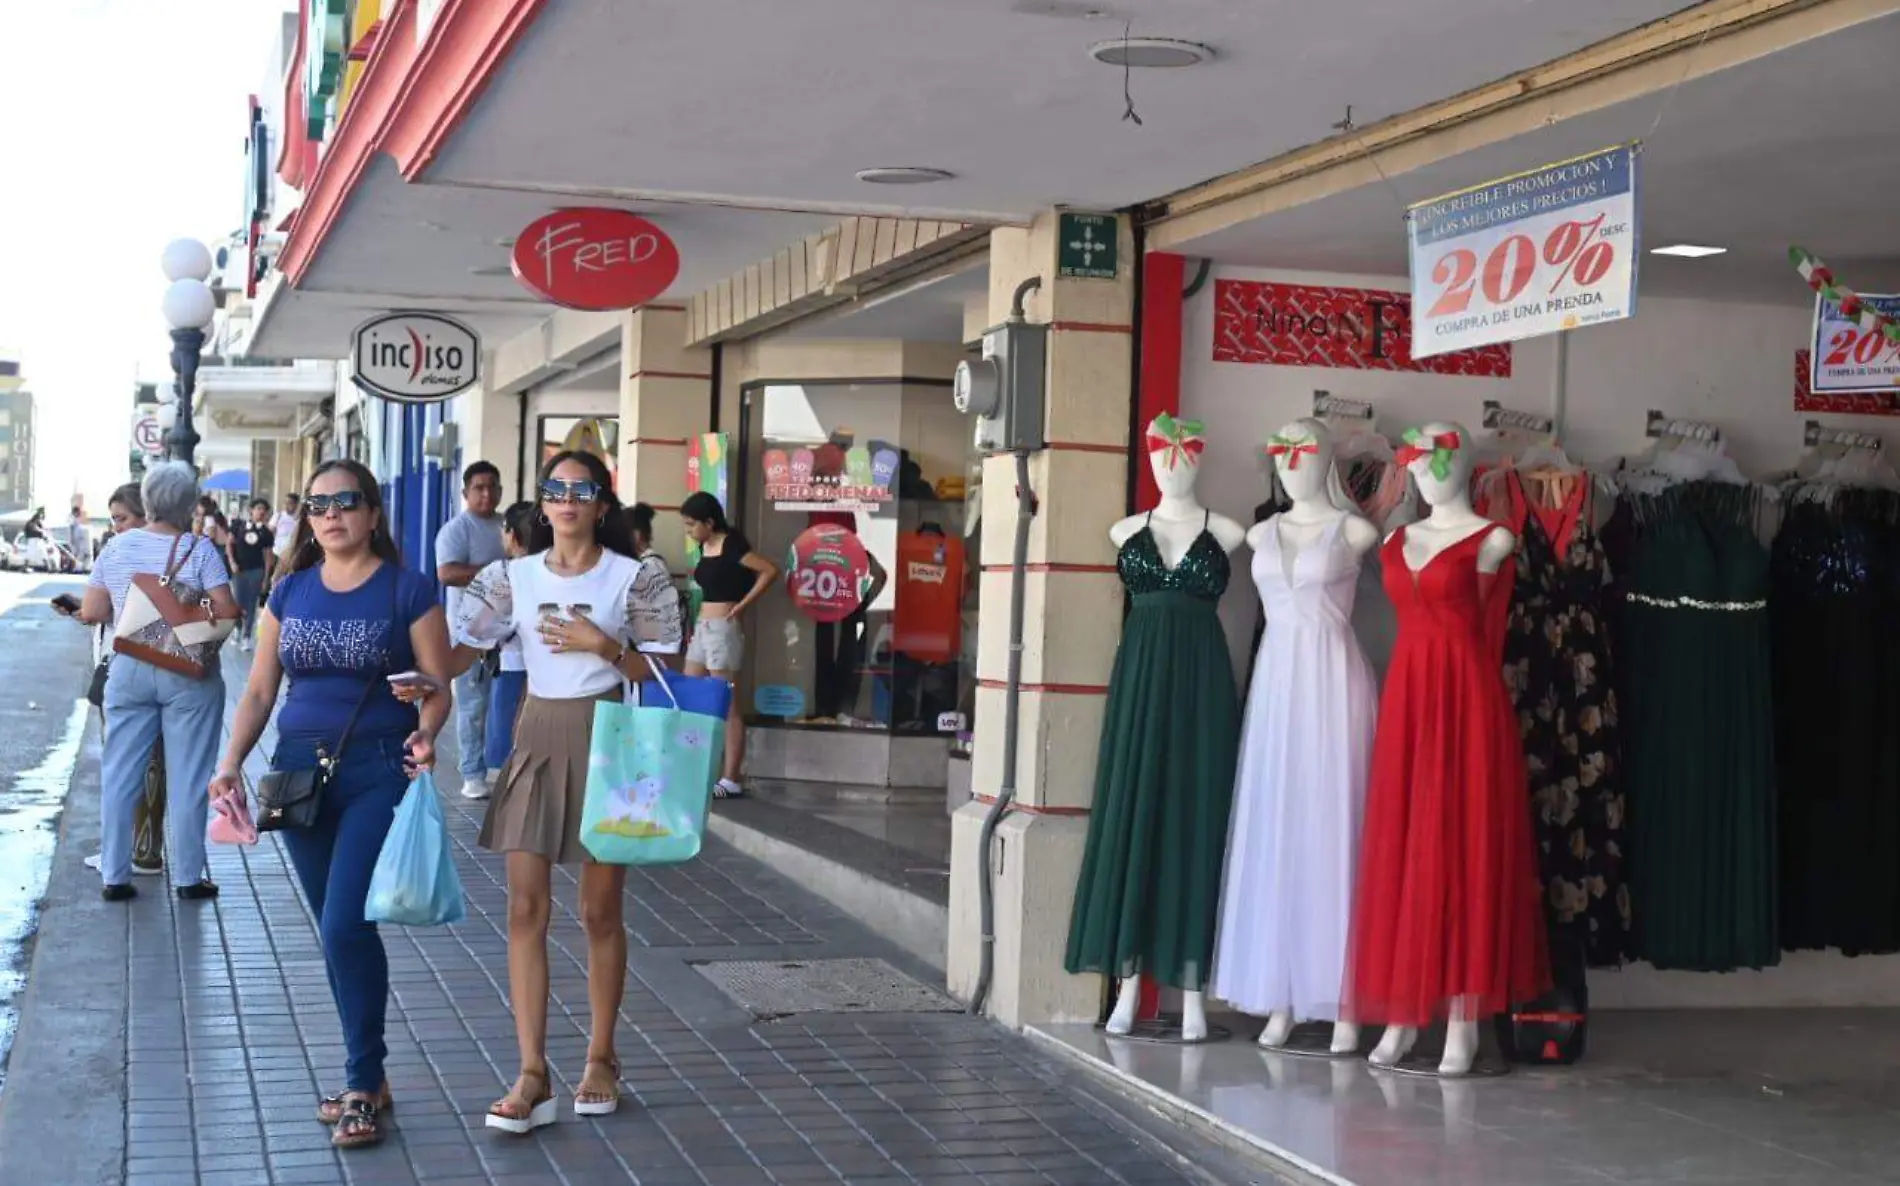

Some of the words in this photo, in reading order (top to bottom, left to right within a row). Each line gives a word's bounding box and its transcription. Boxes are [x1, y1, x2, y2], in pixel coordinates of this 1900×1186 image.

[1605, 154, 1618, 171] Y
[1432, 222, 1459, 238] LOS
[1459, 204, 1529, 232] MEJORES
[1533, 182, 1598, 209] PRECIOS
[535, 222, 658, 290] FRED
[1424, 213, 1614, 318] 20%
[1435, 314, 1489, 336] COMPRA
[1492, 310, 1511, 325] DE
[1513, 304, 1542, 319] UNA
[1546, 291, 1603, 313] PRENDA
